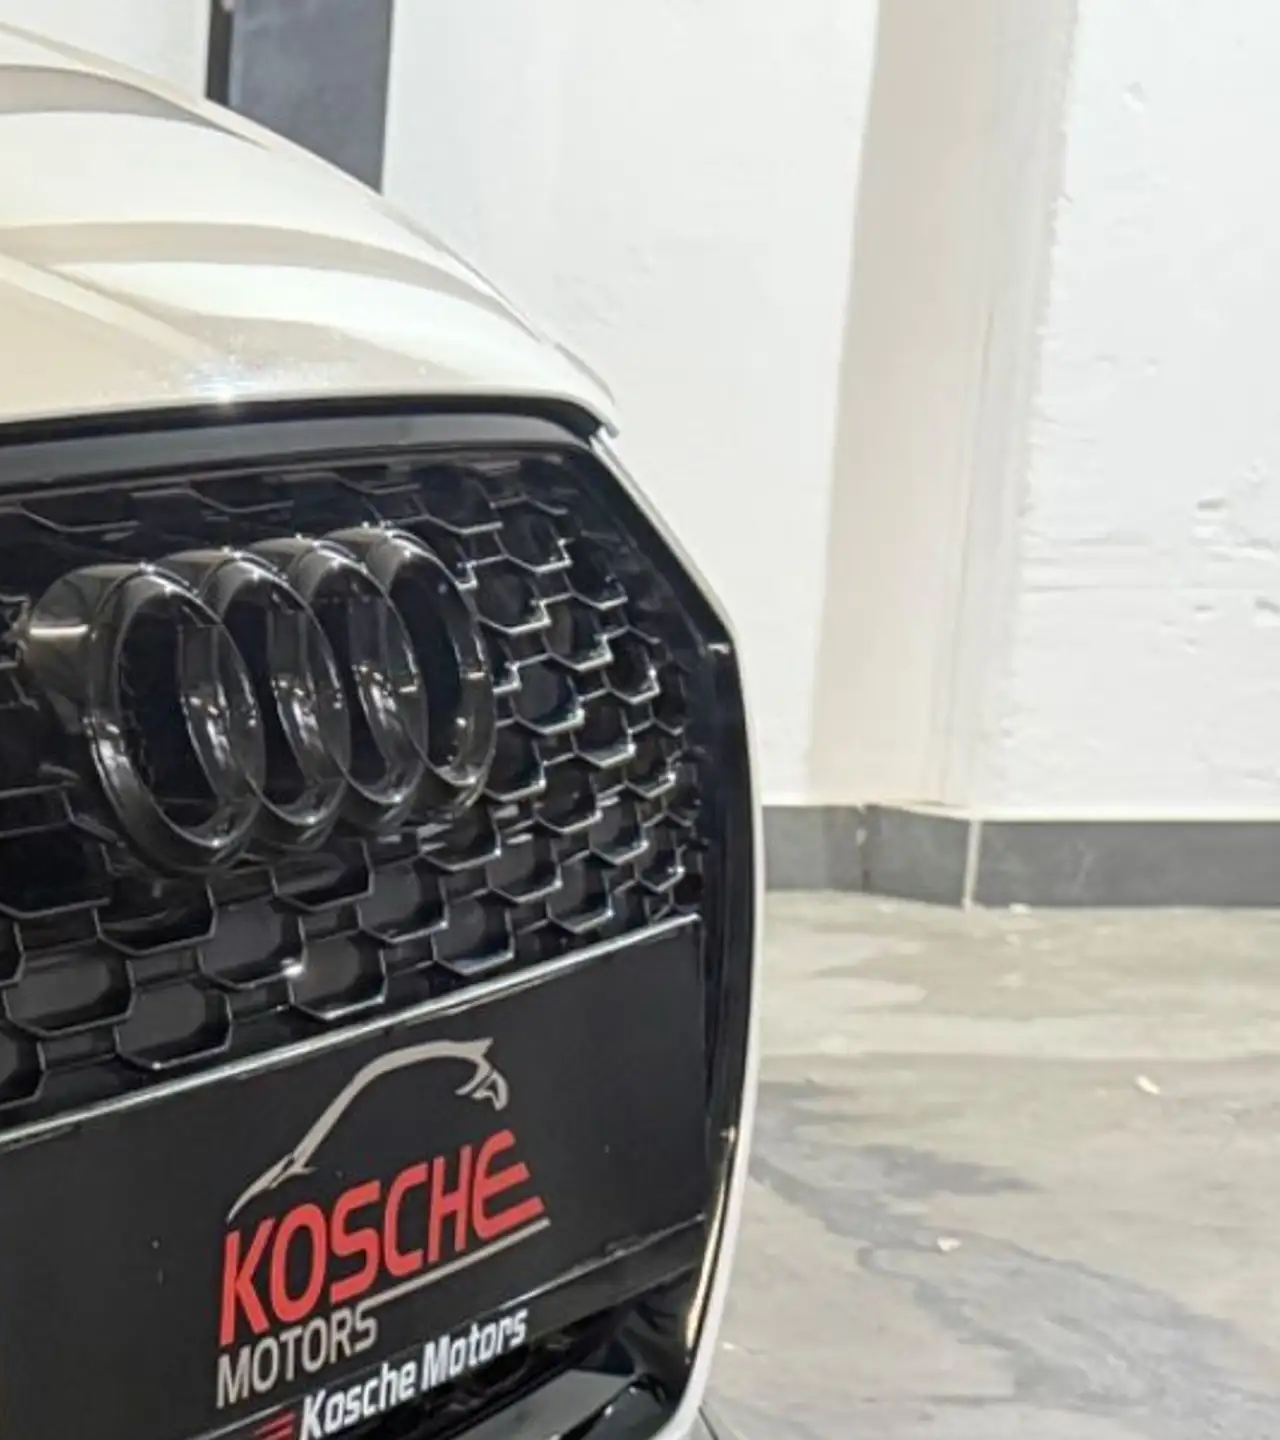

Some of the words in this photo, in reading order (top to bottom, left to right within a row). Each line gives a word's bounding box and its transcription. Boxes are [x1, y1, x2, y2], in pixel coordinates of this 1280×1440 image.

[220, 1128, 544, 1344] KOSCHE
[217, 1303, 378, 1409] MOTORS
[422, 1309, 528, 1395] Motors
